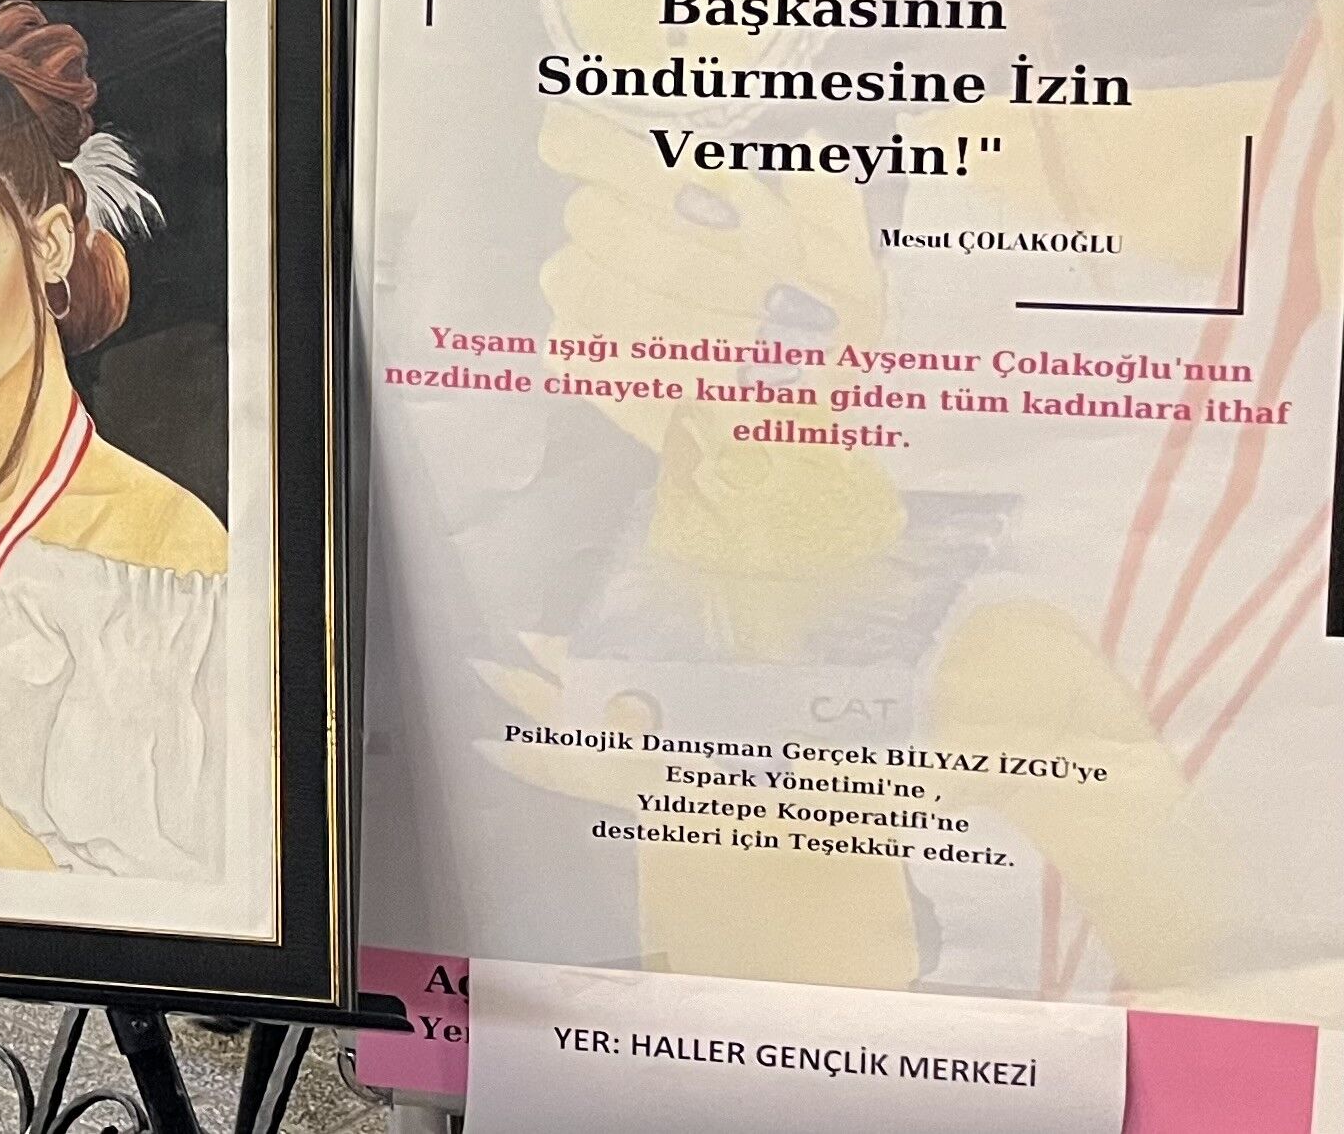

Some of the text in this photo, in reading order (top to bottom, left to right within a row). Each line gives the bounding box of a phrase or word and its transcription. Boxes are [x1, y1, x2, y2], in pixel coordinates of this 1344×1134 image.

[538, 53, 1133, 107] Söndürmesine İzin
[649, 129, 1002, 185] Vermeyin!"
[880, 228, 1123, 256] Mesut ÇOLAKOĞLU
[429, 326, 1254, 388] Yaşam ışığı söndürülen Ayşenur Çolakoğlu'nun
[385, 365, 1292, 426] nezdinde cinayete kurban giden tüm kadınlara ithaf
[732, 419, 911, 452] edilmiştir.
[504, 725, 1108, 784] Psikolojik Danışman Gerçek BİLYAZ İZGÜ'ye
[665, 765, 926, 799] Espark Yönetimi'ne
[637, 793, 970, 833] Yıldıztepe Kooperatifi'ne
[591, 820, 1015, 867] destekleri için Teşekkür ederiz.
[552, 1026, 1039, 1088] YER: HALLER GENÇLİK MERKEZİ
